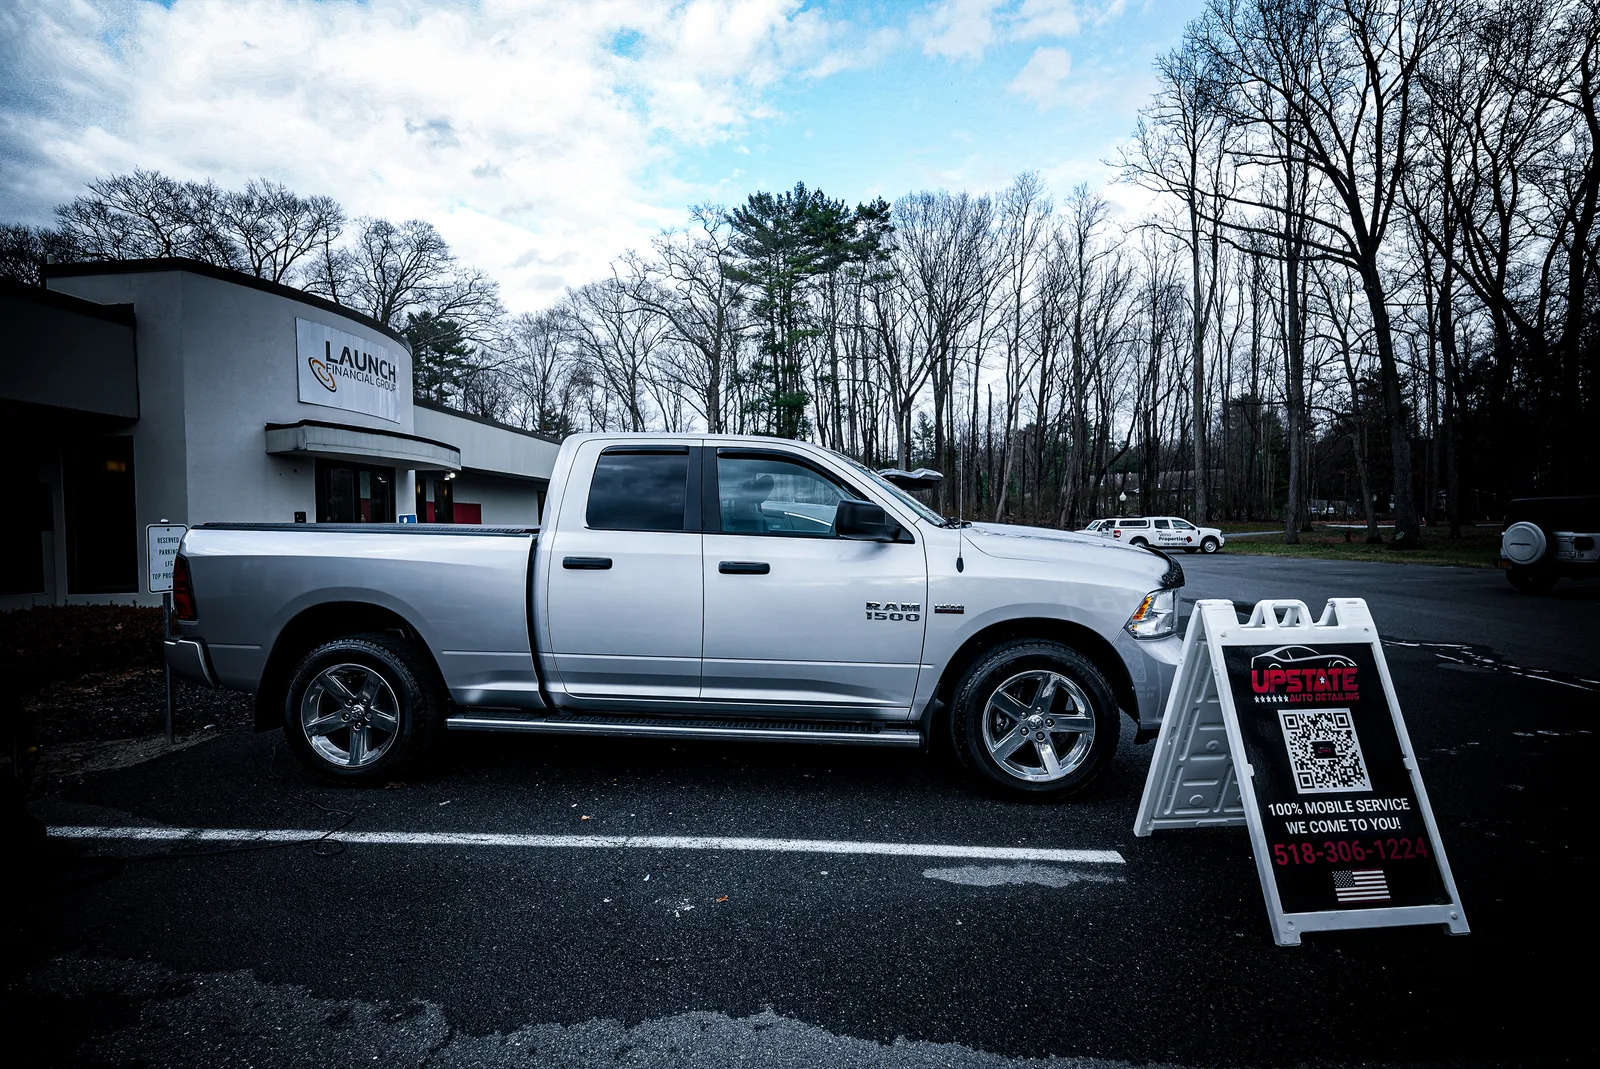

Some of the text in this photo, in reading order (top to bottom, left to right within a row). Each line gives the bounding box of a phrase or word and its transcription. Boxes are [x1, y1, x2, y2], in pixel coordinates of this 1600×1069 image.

[325, 340, 396, 383] LAUNCH
[326, 362, 397, 393] FINANCIAL GROUP
[865, 601, 921, 612] RAM
[865, 612, 920, 622] 1500
[1251, 668, 1359, 693] UPSTATE
[1289, 692, 1360, 703] AUTO DETAILING
[1268, 798, 1410, 816] 100% MOBILE SERVICE
[1285, 817, 1402, 835] WE COME TO YOU!
[1274, 837, 1429, 866] 518-306-1224
